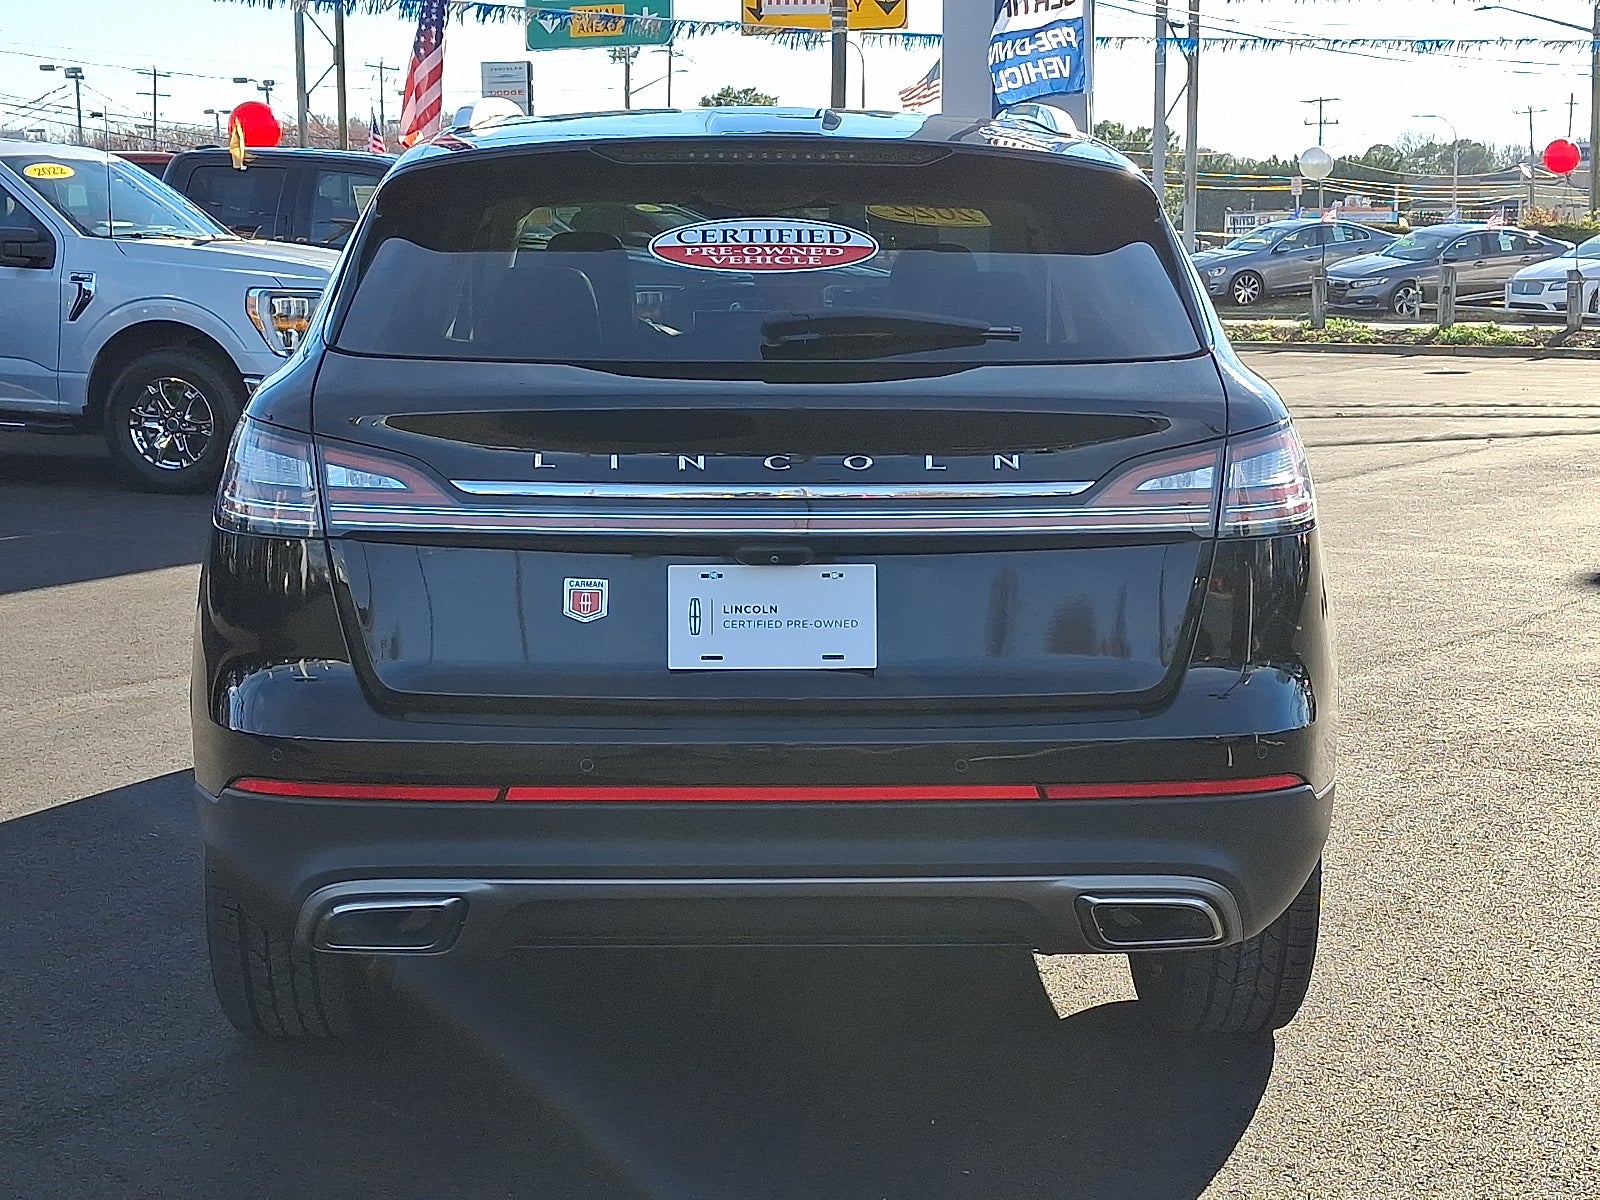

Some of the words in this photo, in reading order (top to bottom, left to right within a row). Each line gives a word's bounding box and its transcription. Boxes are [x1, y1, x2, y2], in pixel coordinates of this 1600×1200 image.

[33, 166, 67, 177] 2022
[676, 228, 852, 244] CERTIFIED
[684, 246, 845, 257] PRE-OWNED
[708, 255, 823, 266] VEHICLE
[534, 452, 1020, 471] LINCOLN
[569, 580, 604, 588] CARMAN
[722, 604, 779, 615] LINCOLN
[722, 619, 783, 629] CERTIFIED
[786, 619, 860, 629] PRE-OWNED
